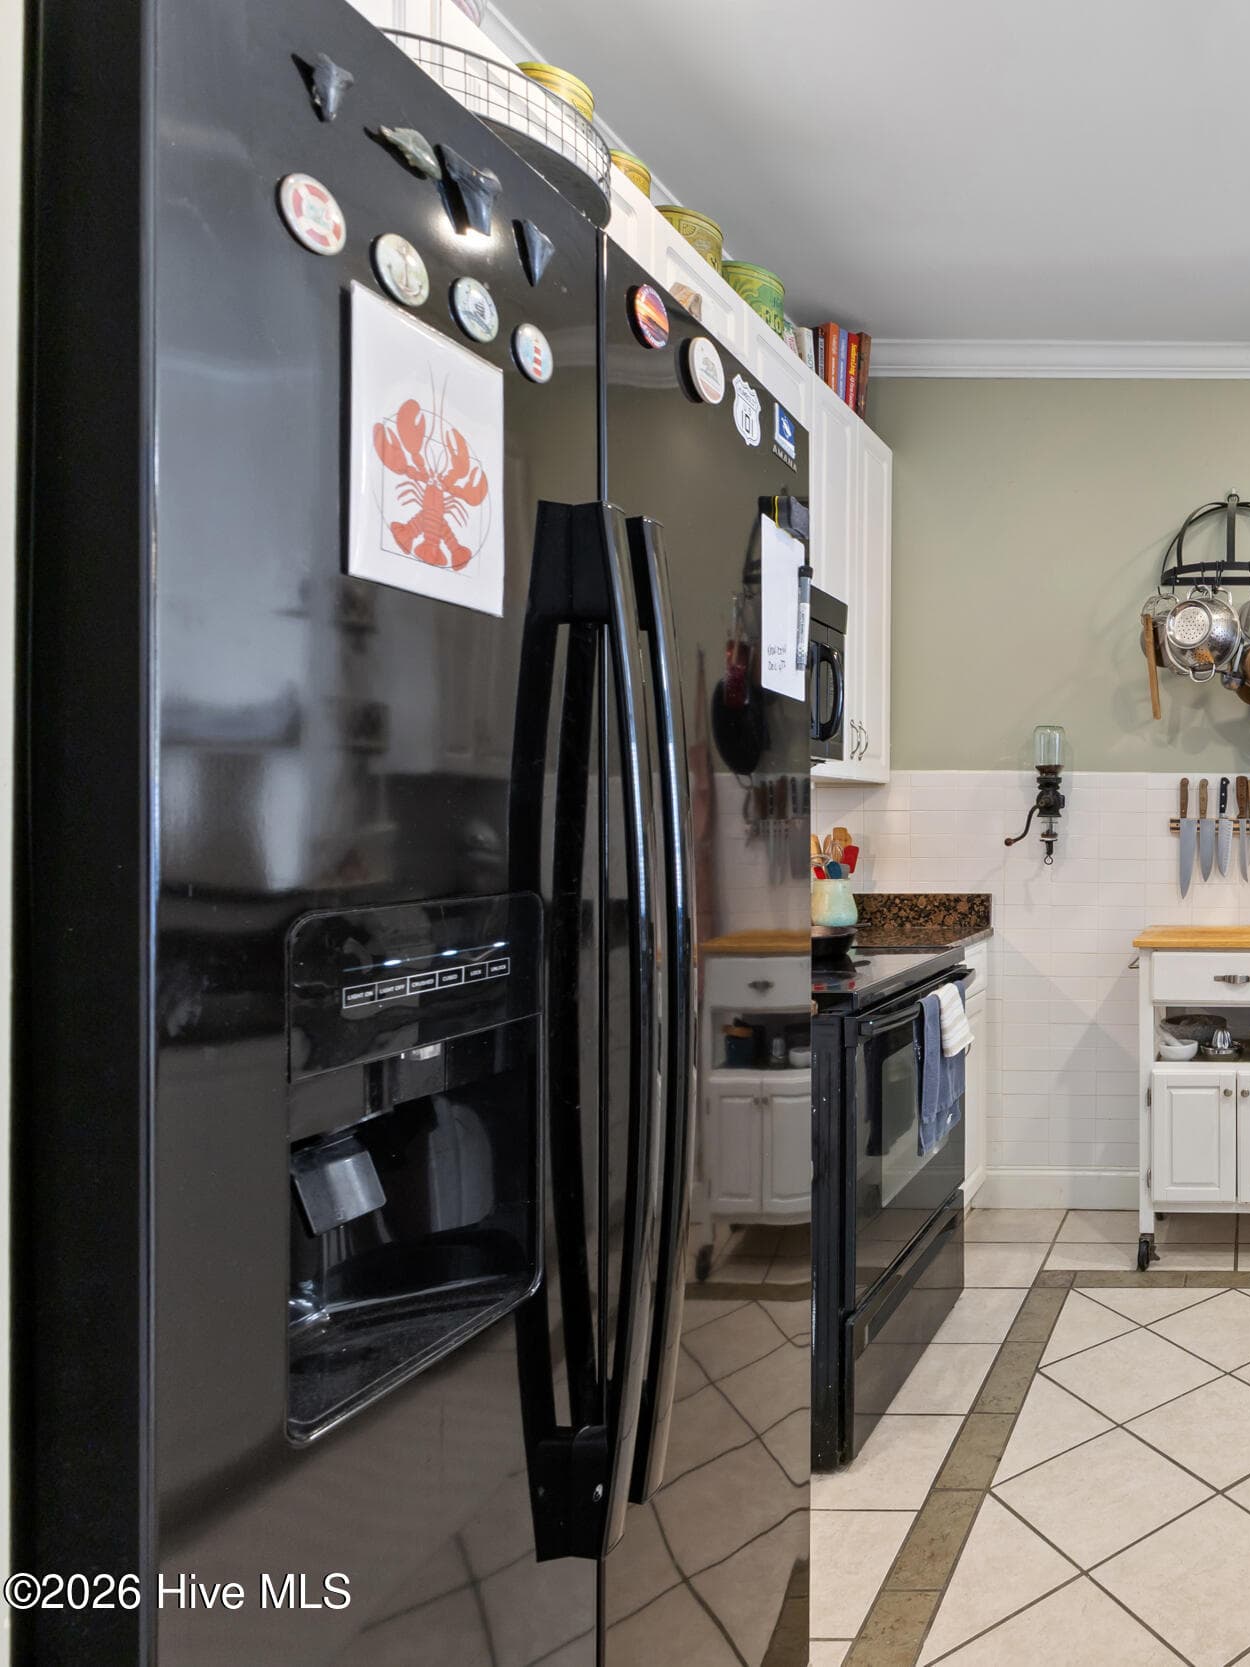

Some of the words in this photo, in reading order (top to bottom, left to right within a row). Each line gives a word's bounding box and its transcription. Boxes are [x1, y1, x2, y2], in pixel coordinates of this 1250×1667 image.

[772, 444, 798, 472] AMANA
[379, 986, 394, 994] LIGHT
[347, 992, 364, 1001] LIGHT
